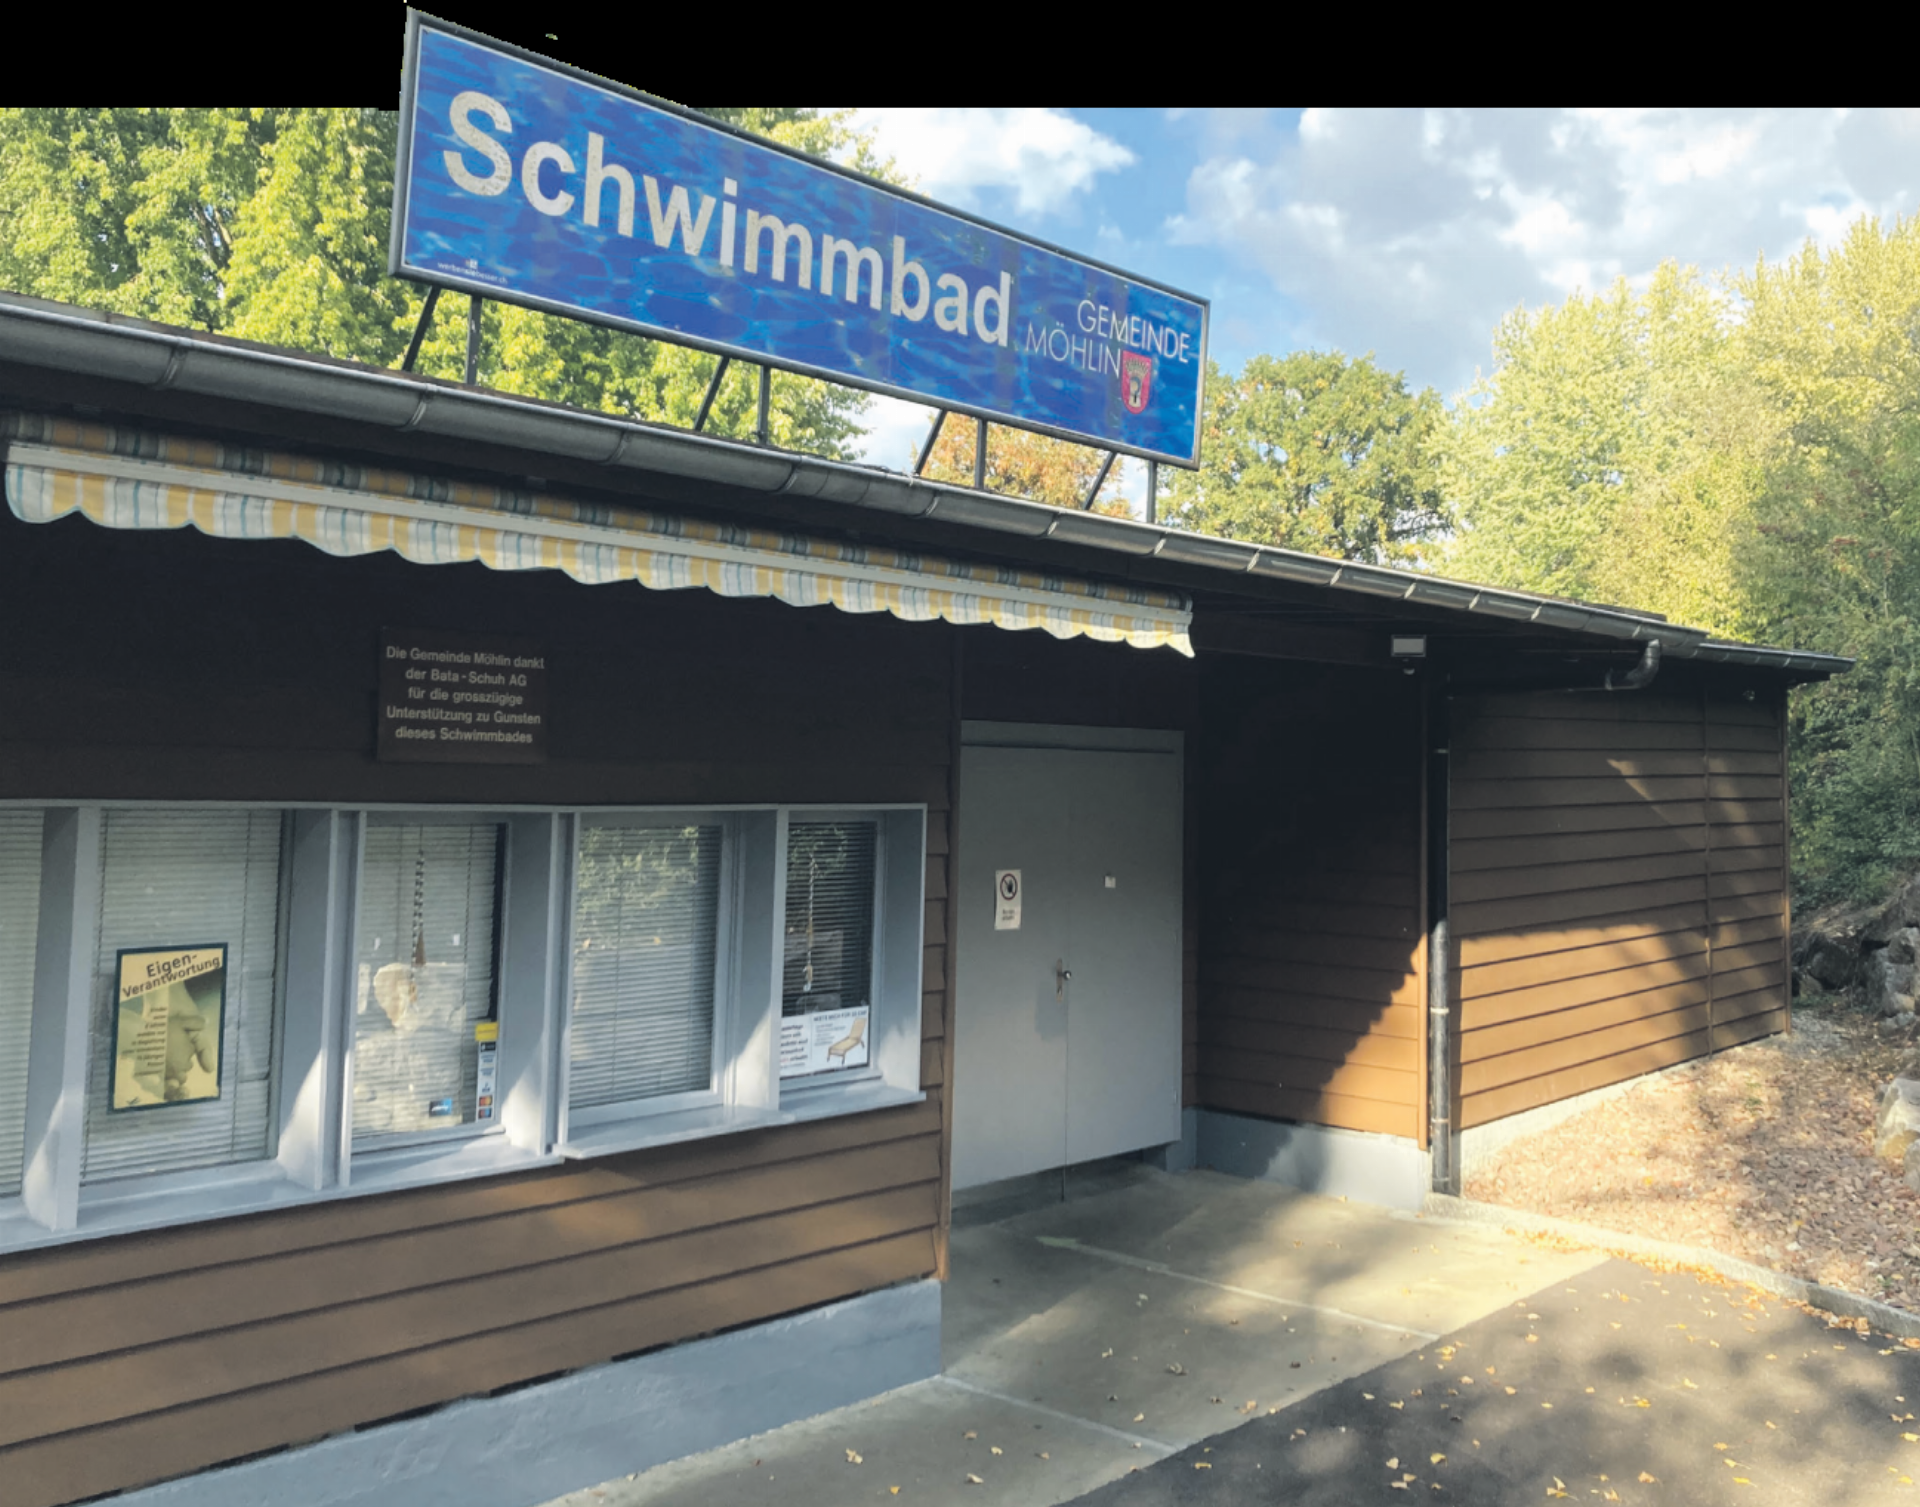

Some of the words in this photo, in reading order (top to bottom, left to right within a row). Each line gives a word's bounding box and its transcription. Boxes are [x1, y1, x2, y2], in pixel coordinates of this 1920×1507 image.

[443, 91, 1011, 347] Schwimmbad
[1077, 300, 1190, 364] GEMEINDE
[1025, 323, 1121, 379] MÖHLIN
[386, 646, 407, 660] Die
[410, 648, 471, 664] Gemeinde
[474, 652, 511, 667] Möhlin
[514, 656, 545, 669] dankt
[405, 667, 427, 680] der
[509, 674, 528, 687] AG
[408, 687, 426, 699] für
[430, 688, 449, 700] die
[452, 690, 523, 707] grosszügige
[386, 705, 473, 724] Unterstützung
[476, 712, 490, 723] zu
[493, 710, 541, 725] Gunsten
[395, 726, 436, 740] dieses
[440, 727, 533, 743] Schwimmbades
[122, 957, 221, 998] Verantwortung
[146, 953, 198, 978] Eigen-
